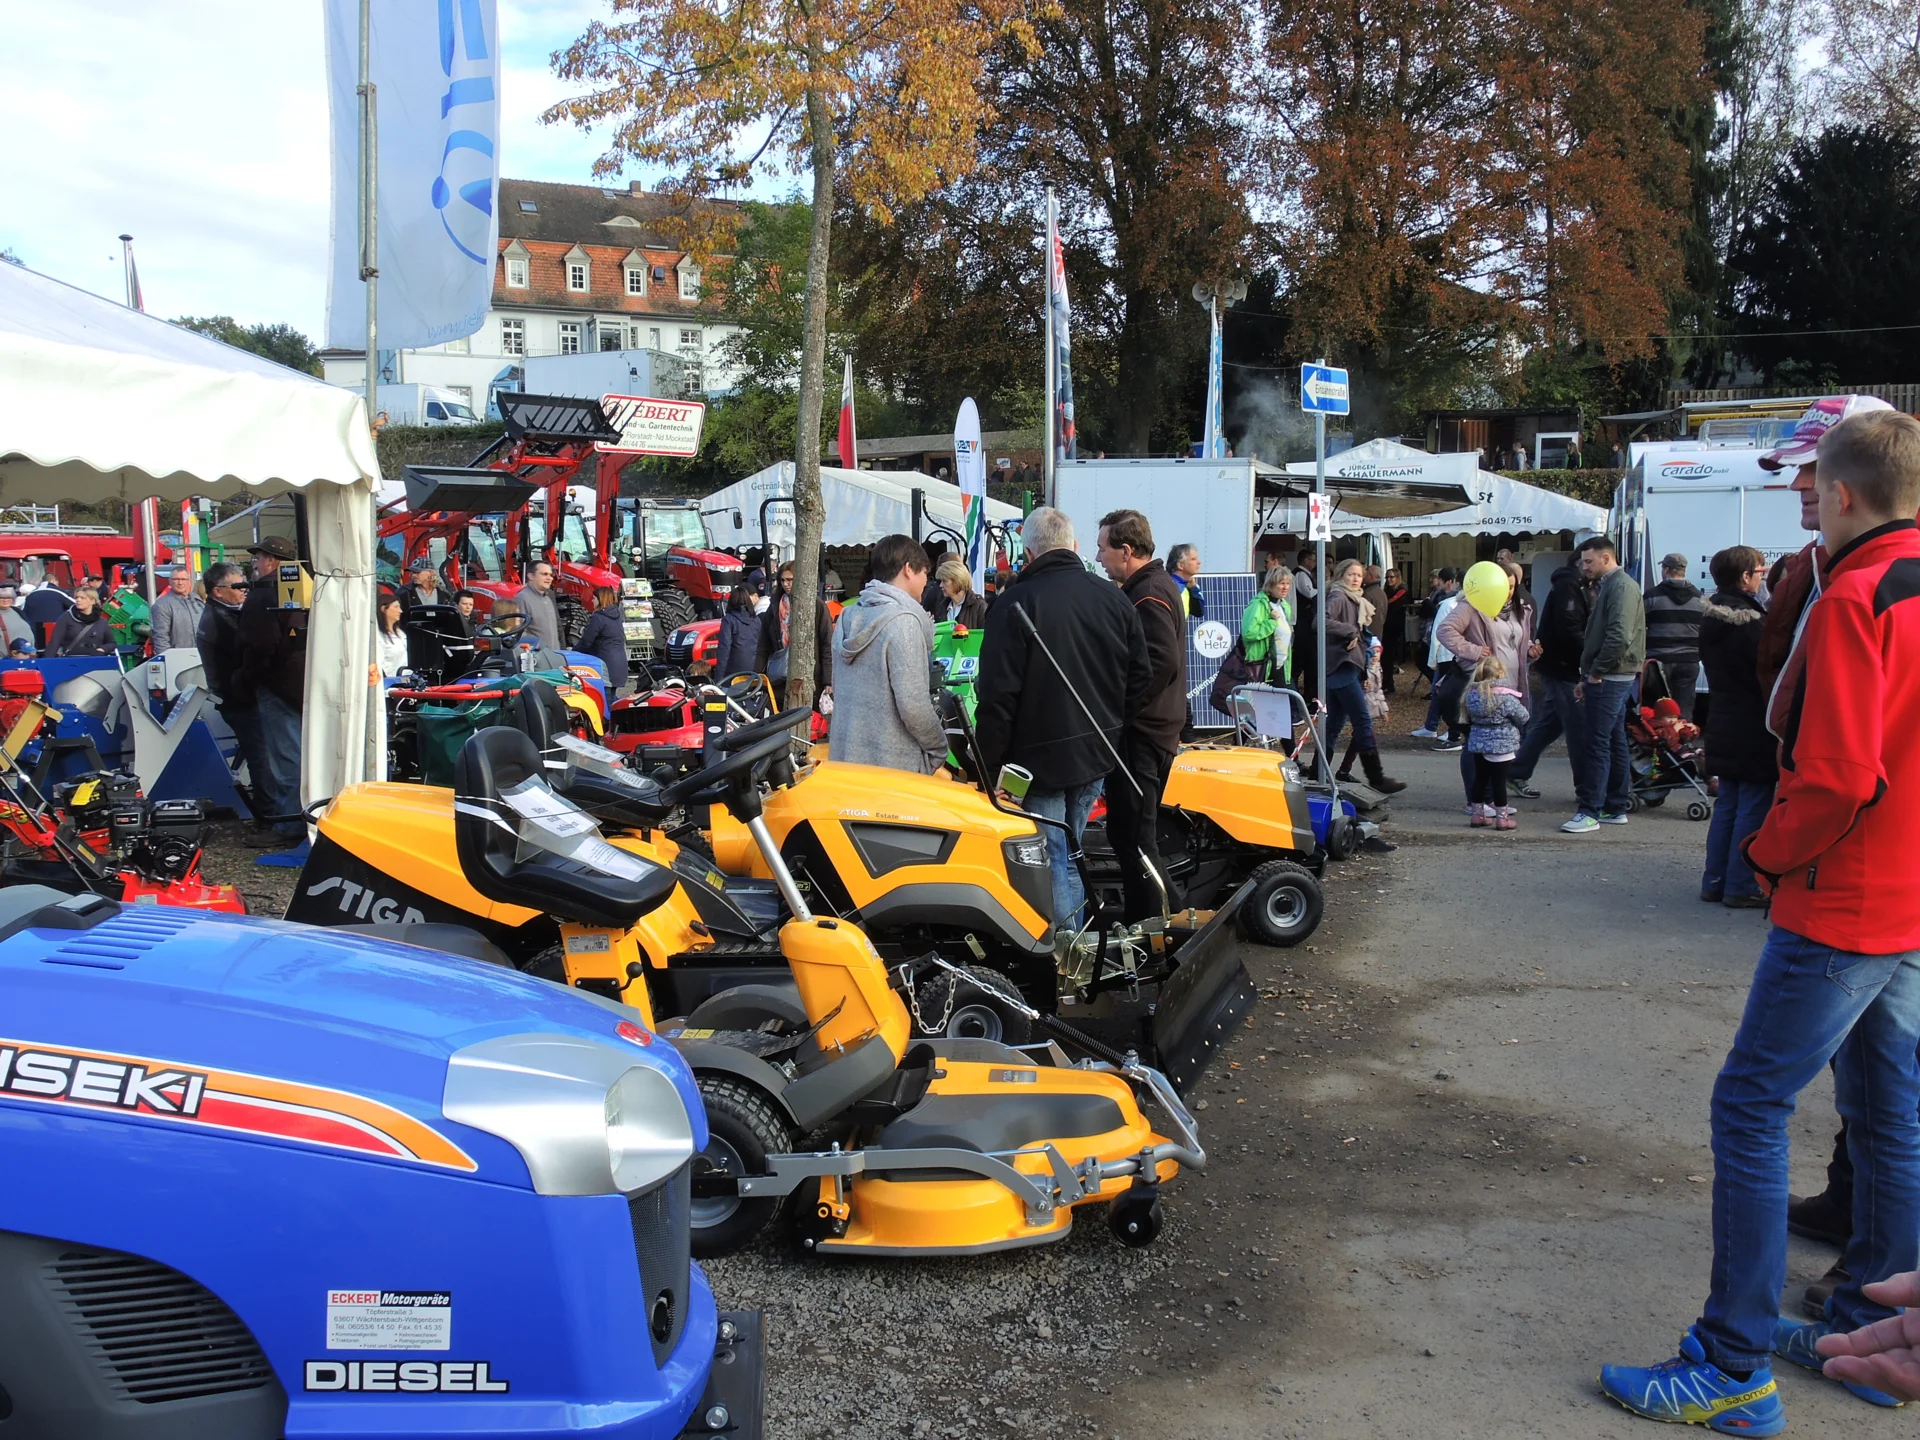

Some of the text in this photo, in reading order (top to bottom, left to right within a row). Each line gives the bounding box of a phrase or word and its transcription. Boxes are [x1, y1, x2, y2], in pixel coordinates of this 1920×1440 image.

[632, 404, 692, 422] EBERT
[648, 421, 694, 432] Gartentechnik
[1338, 467, 1423, 478] SCHAUERMANN
[1661, 464, 1713, 477] carado
[1477, 516, 1533, 525] 6049/7516
[1204, 640, 1228, 649] Heiz
[838, 809, 869, 817] STIGA
[307, 876, 426, 924] STIGA
[0, 1048, 205, 1114] ISEKI
[331, 1293, 449, 1306] ECKERT Motorgeräte
[304, 1361, 508, 1391] DIESEL
[1724, 1384, 1773, 1406] salomon
